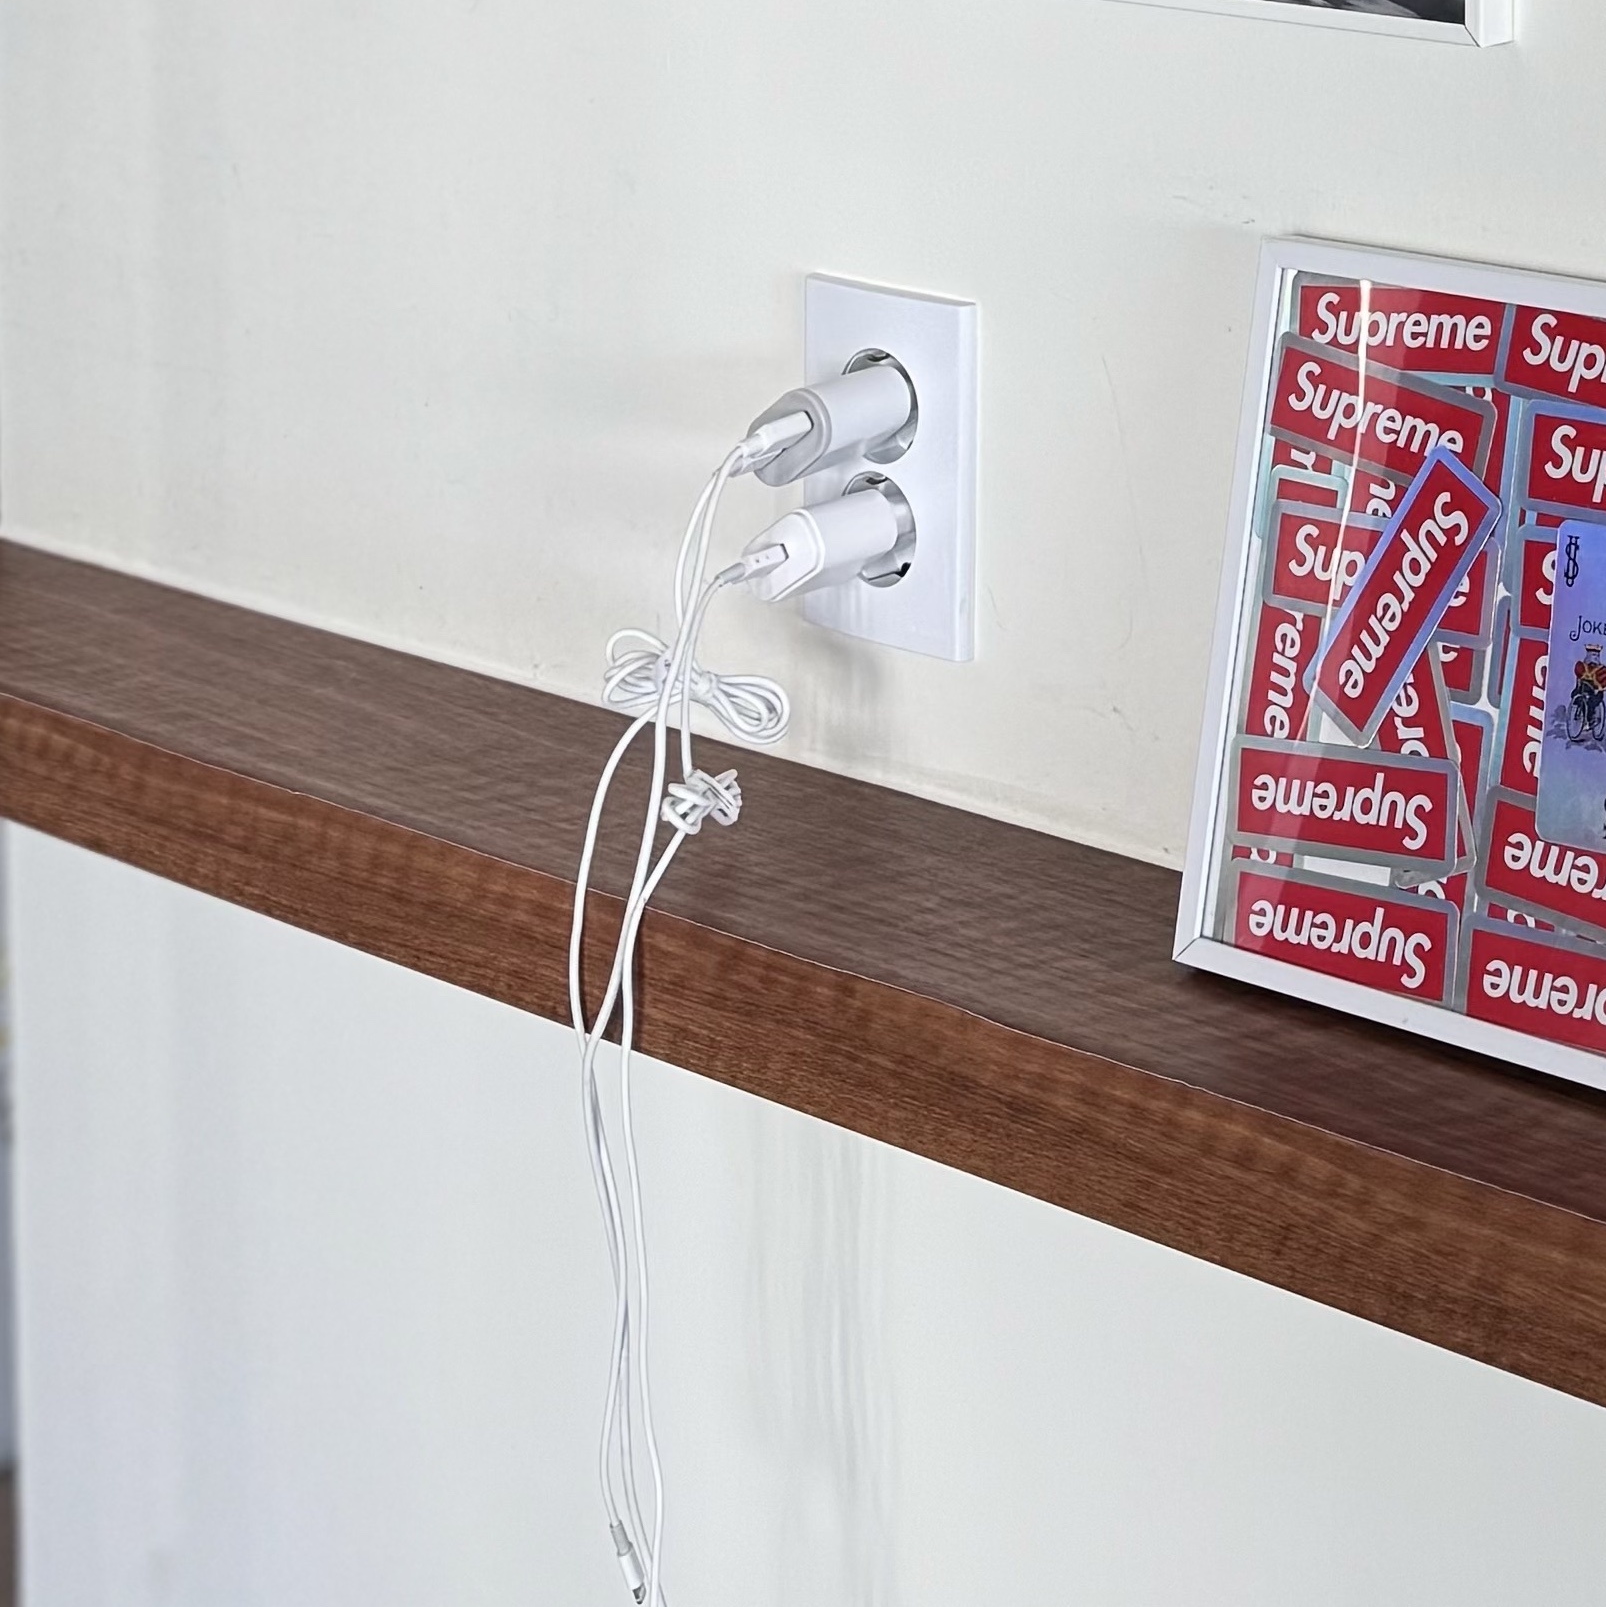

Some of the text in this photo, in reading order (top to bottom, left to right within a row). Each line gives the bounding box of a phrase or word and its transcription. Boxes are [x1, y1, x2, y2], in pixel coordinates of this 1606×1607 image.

[1311, 292, 1491, 352] Supreme
[1288, 361, 1463, 457] Supreme
[1338, 492, 1469, 698] Supreme
[1250, 774, 1433, 852] Supreme
[1248, 899, 1432, 989] Supreme
